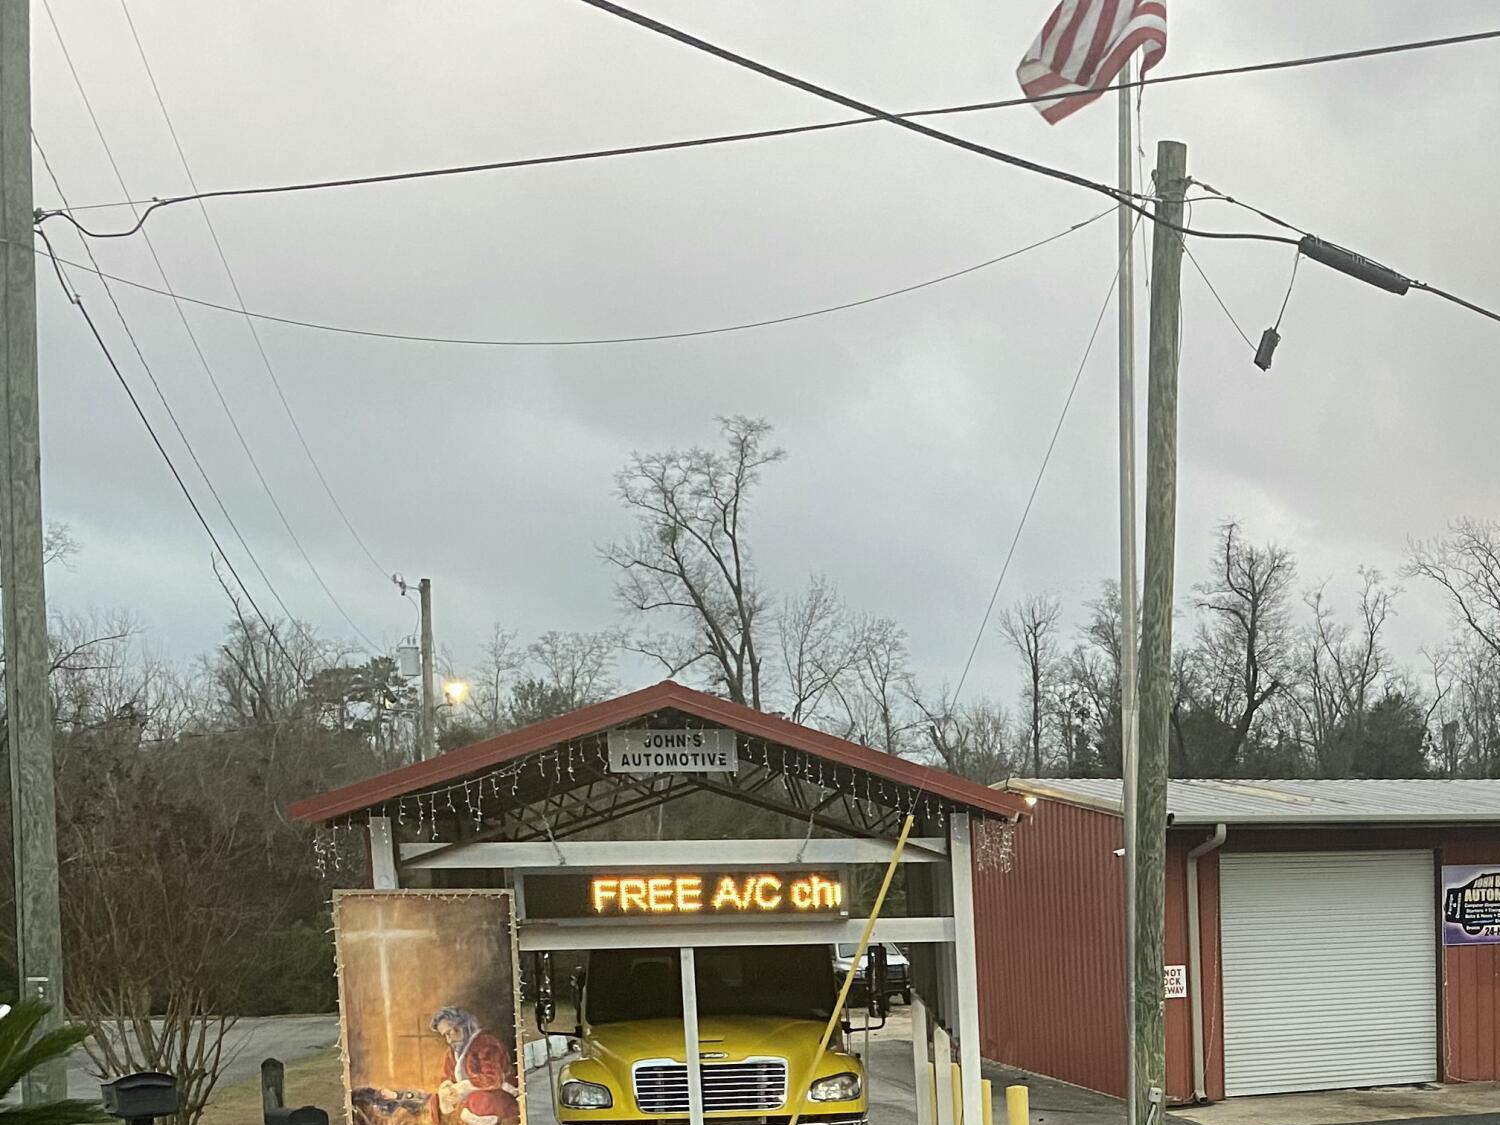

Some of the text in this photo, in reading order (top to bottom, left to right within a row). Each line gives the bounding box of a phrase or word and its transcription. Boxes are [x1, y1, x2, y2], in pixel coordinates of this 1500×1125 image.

[644, 734, 703, 748] JOHN'S
[621, 753, 728, 766] AUTOMOTIVE
[1474, 875, 1494, 888] JOHN
[592, 874, 842, 913] FREE A/C ch
[1164, 968, 1182, 977] NOT
[1164, 977, 1182, 986] OCK
